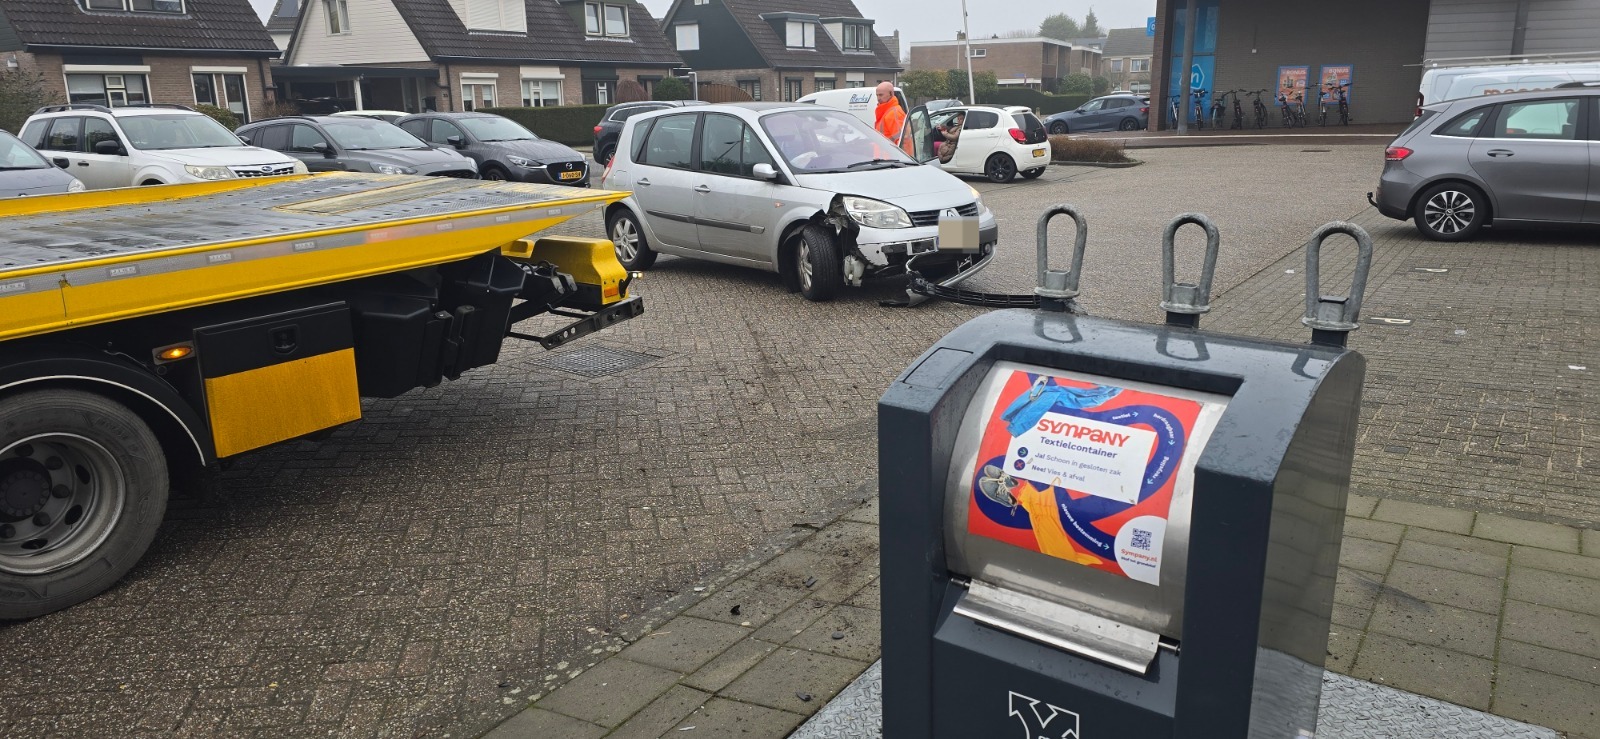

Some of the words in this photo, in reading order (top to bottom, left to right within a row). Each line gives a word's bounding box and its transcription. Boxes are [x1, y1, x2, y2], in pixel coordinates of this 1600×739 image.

[1112, 412, 1131, 420] textiel
[1040, 436, 1118, 459] Textielcontainer
[1031, 464, 1046, 473] Nee!
[1047, 467, 1061, 476] Vies
[1068, 472, 1086, 482] afval
[1046, 454, 1070, 465] Schoon
[1079, 462, 1108, 473] gesloten
[1109, 468, 1122, 476] zak
[1120, 548, 1158, 563] Sympany.nl
